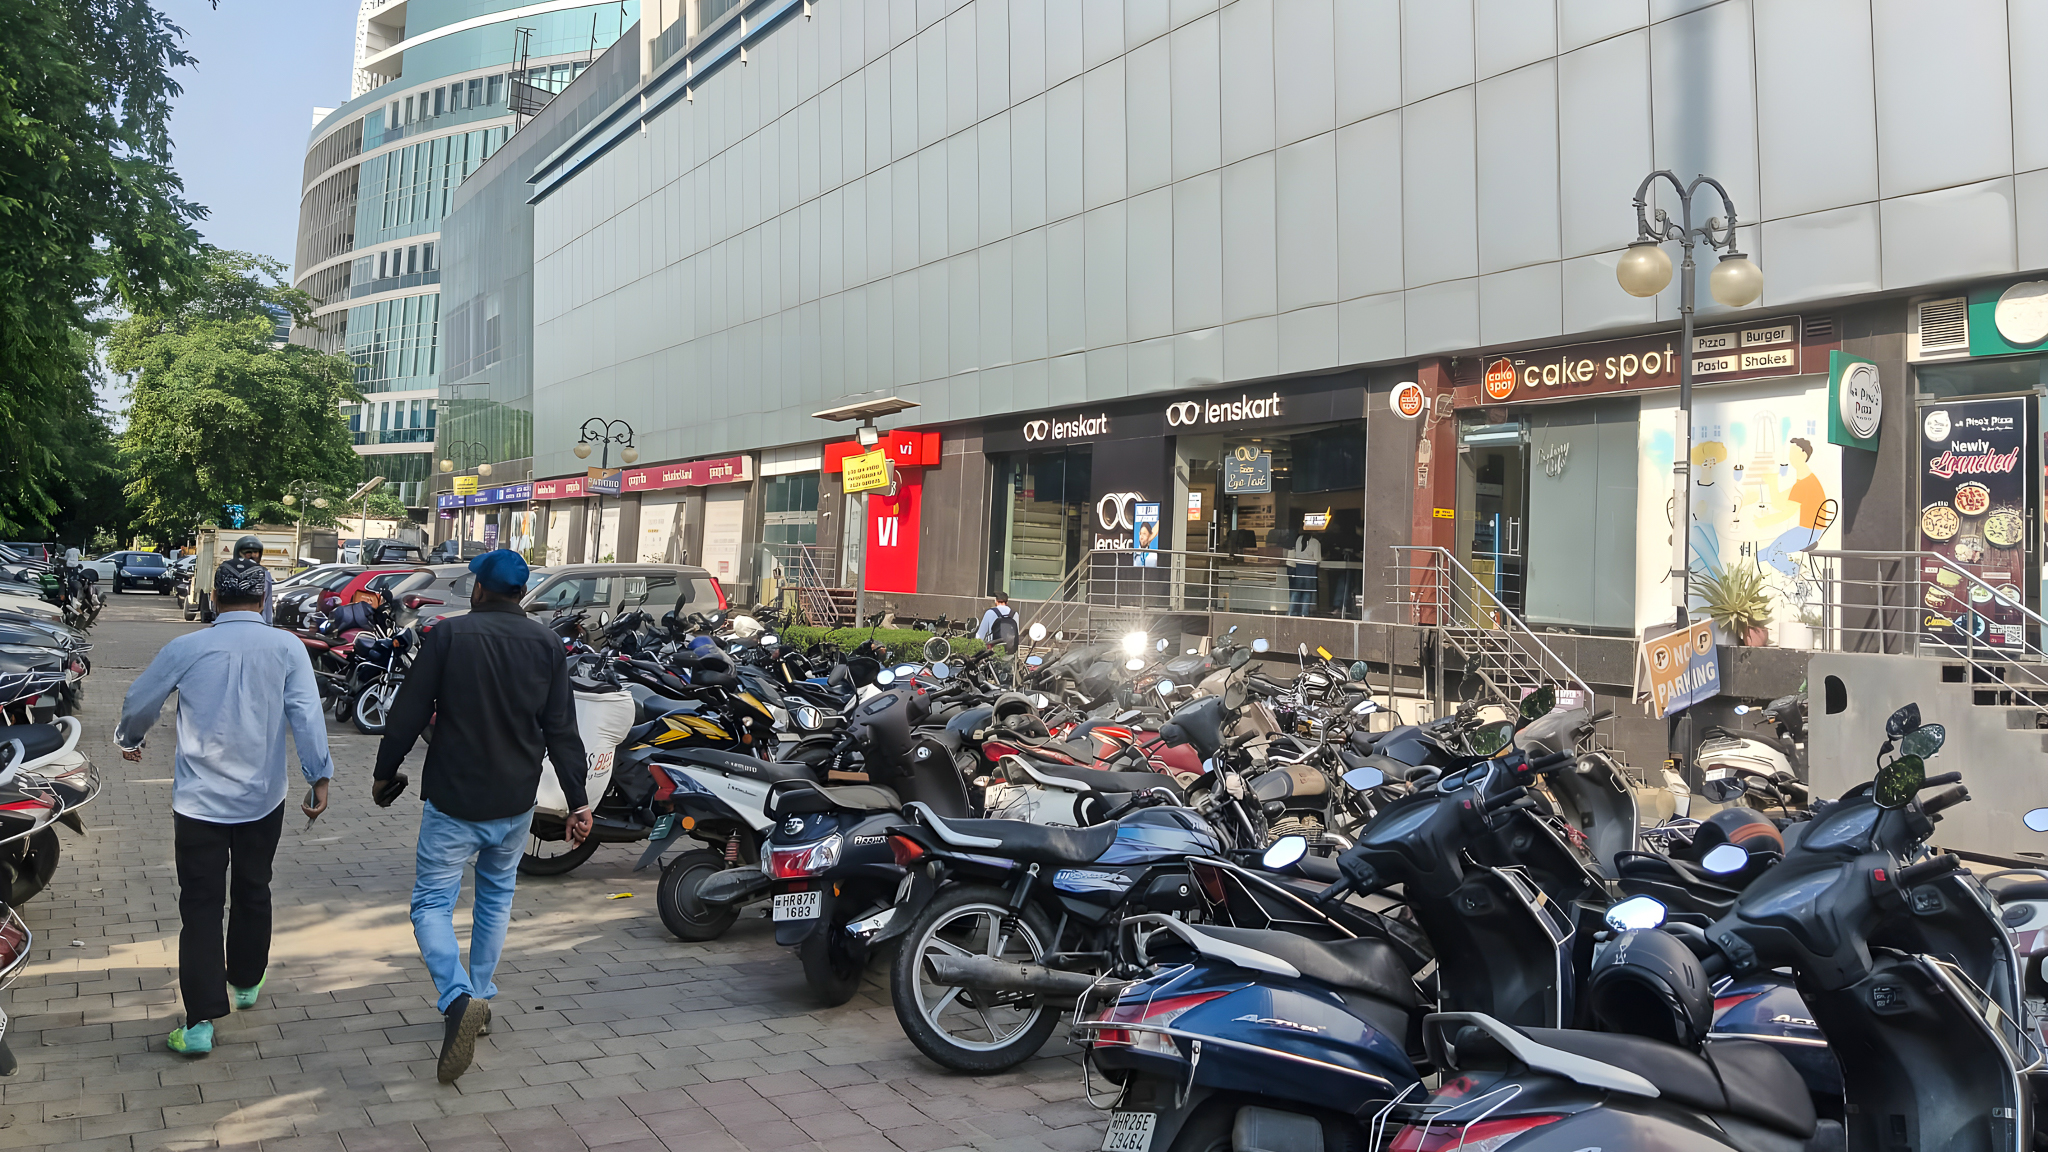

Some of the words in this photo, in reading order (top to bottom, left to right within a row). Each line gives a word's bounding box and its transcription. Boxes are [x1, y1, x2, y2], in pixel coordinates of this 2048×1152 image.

[1746, 328, 1786, 343] Burger
[1699, 338, 1726, 349] Pizza
[1523, 355, 1595, 388] cake
[1604, 342, 1675, 385] spot
[1697, 359, 1729, 372] Pasta
[1744, 353, 1788, 367] Shakes
[1205, 392, 1281, 424] lenskart
[1051, 413, 1108, 440] lenskart
[1951, 438, 1990, 454] Newly
[783, 893, 816, 907] HR87R
[786, 906, 811, 918] 1683
